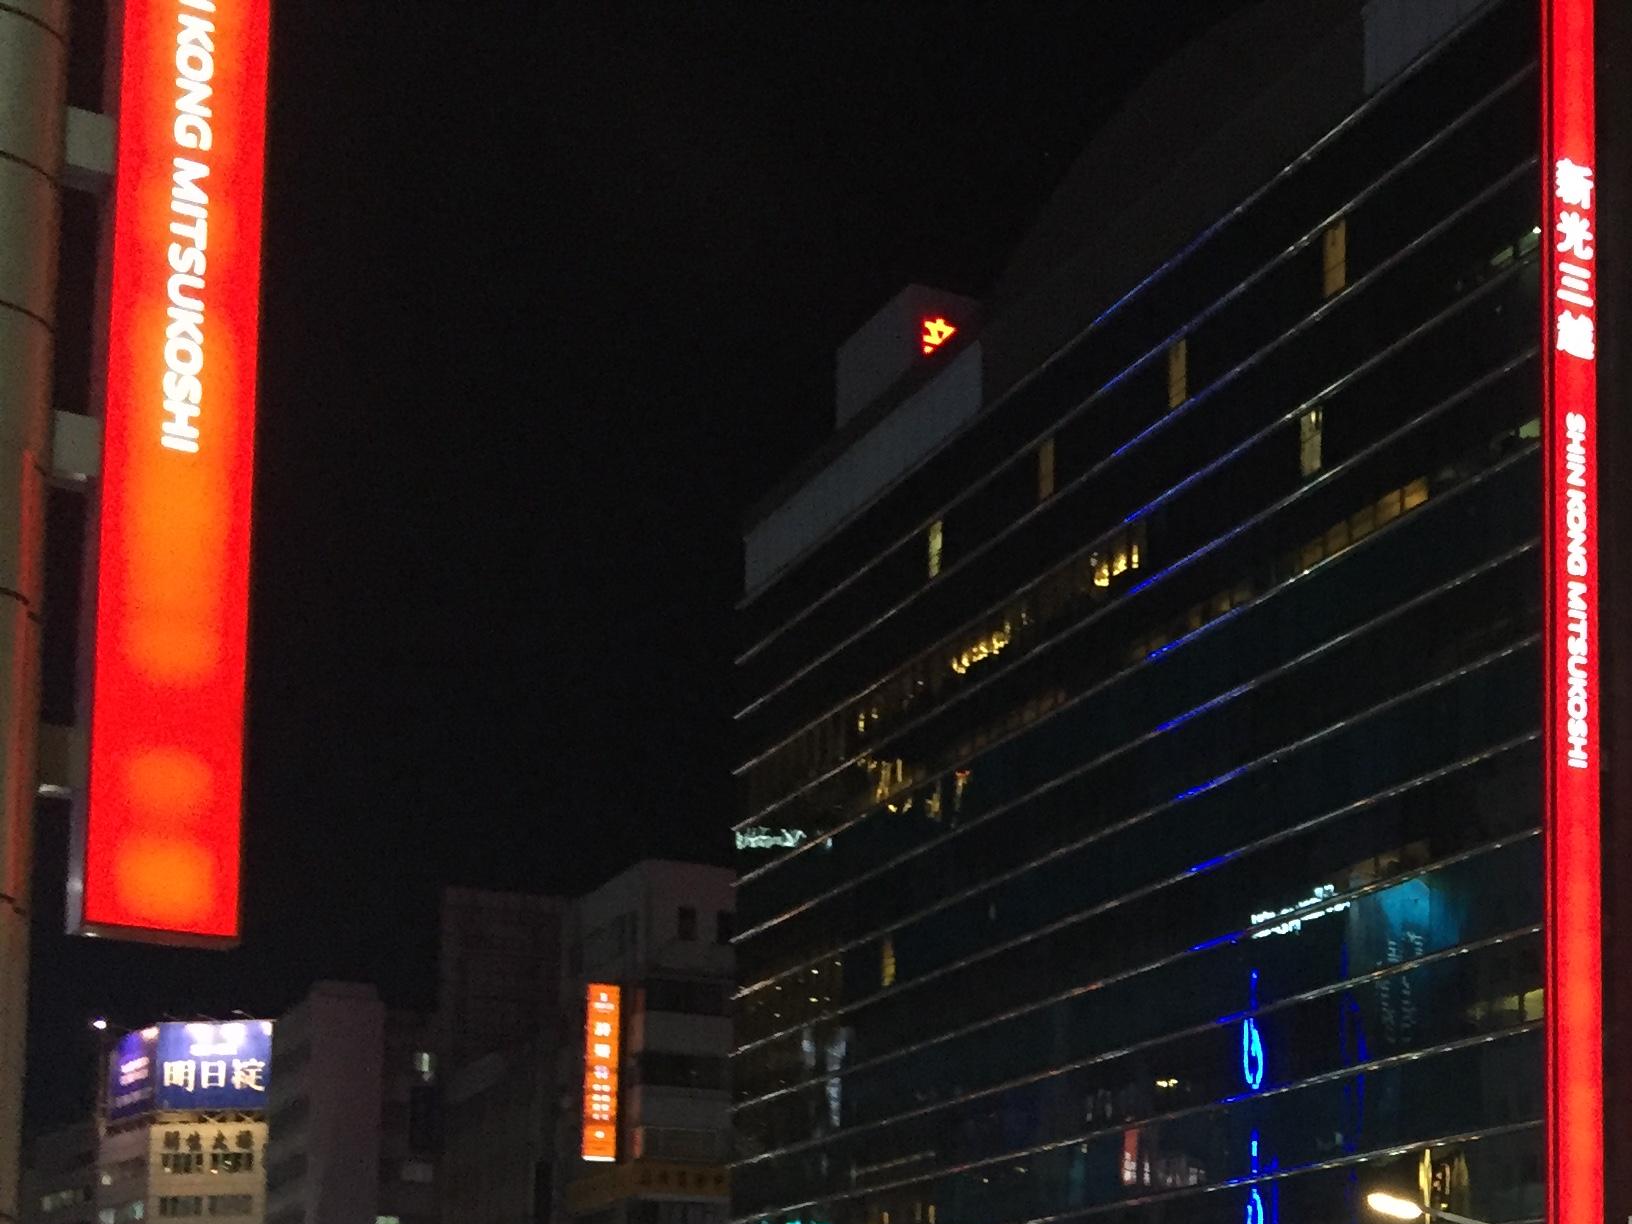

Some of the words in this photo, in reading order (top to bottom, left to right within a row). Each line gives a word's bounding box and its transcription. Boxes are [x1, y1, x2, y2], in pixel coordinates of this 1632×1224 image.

[174, 13, 216, 152] KONG
[160, 157, 210, 453] MITSUKOSHI
[1554, 157, 1594, 361] 新光三越
[1565, 411, 1587, 487] SHIN
[1566, 488, 1588, 577] KONG
[1567, 580, 1589, 769] MITSUKOSHI
